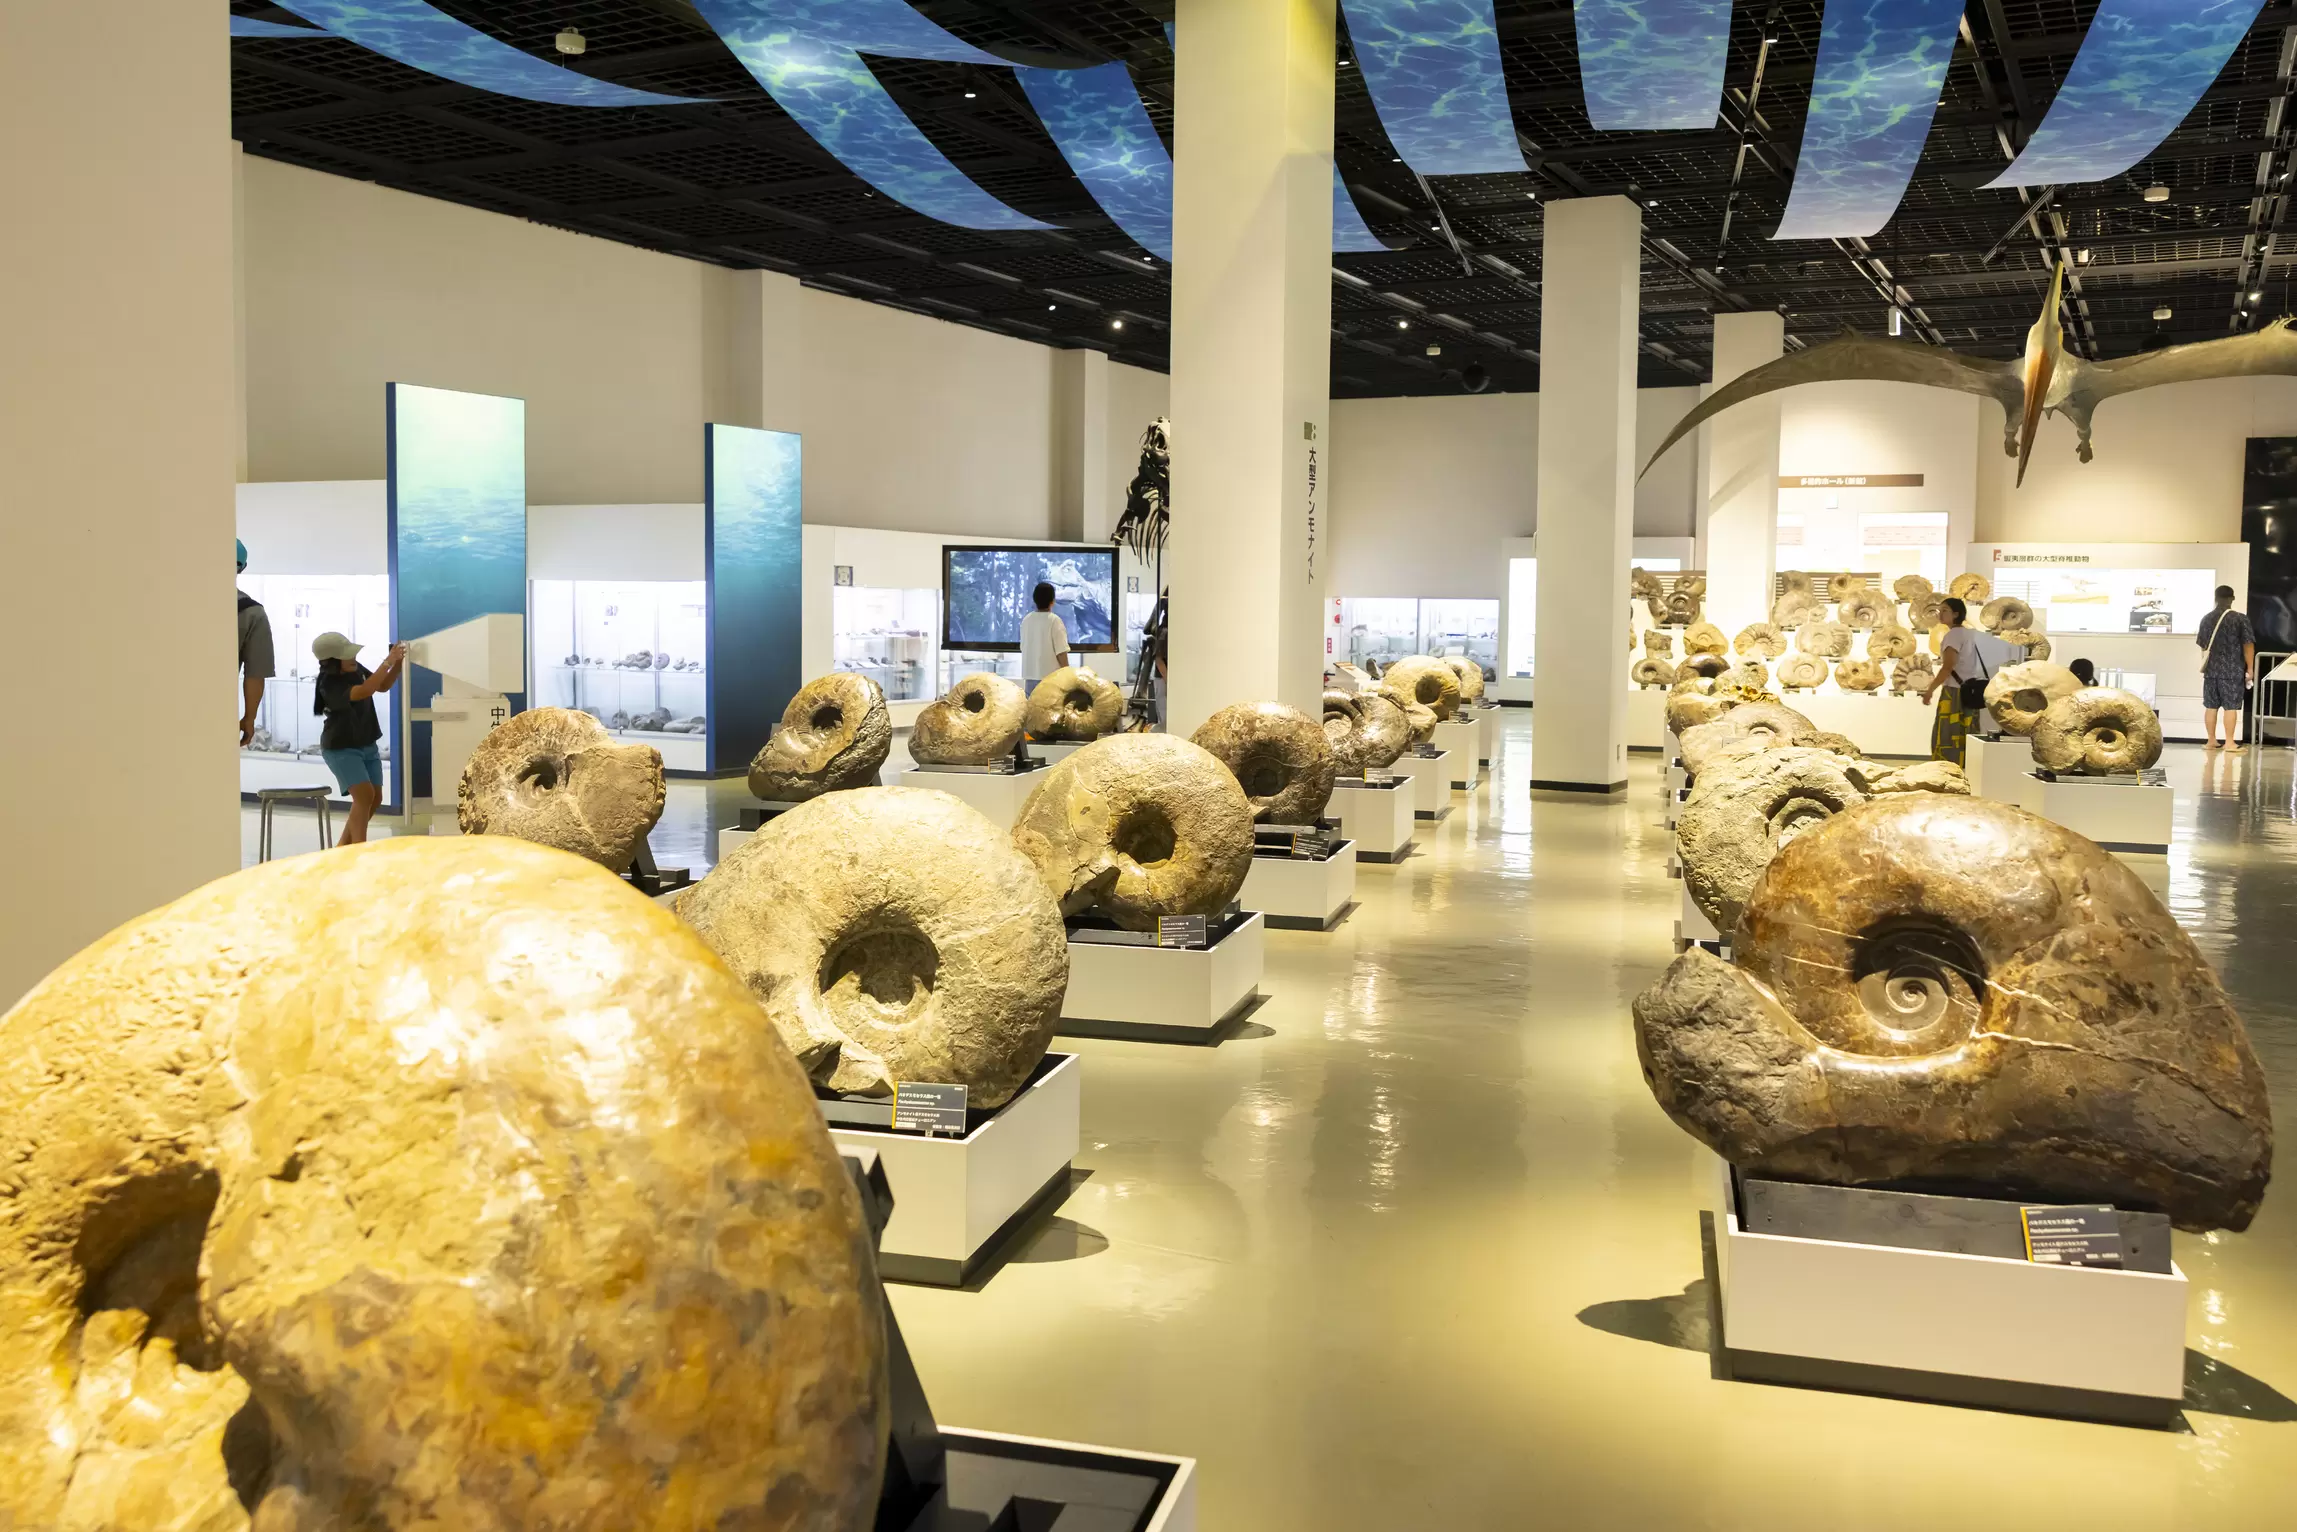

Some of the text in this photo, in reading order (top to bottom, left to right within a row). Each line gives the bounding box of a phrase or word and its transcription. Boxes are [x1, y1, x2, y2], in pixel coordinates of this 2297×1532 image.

[1308, 447, 1316, 585] 大型アンモナイト
